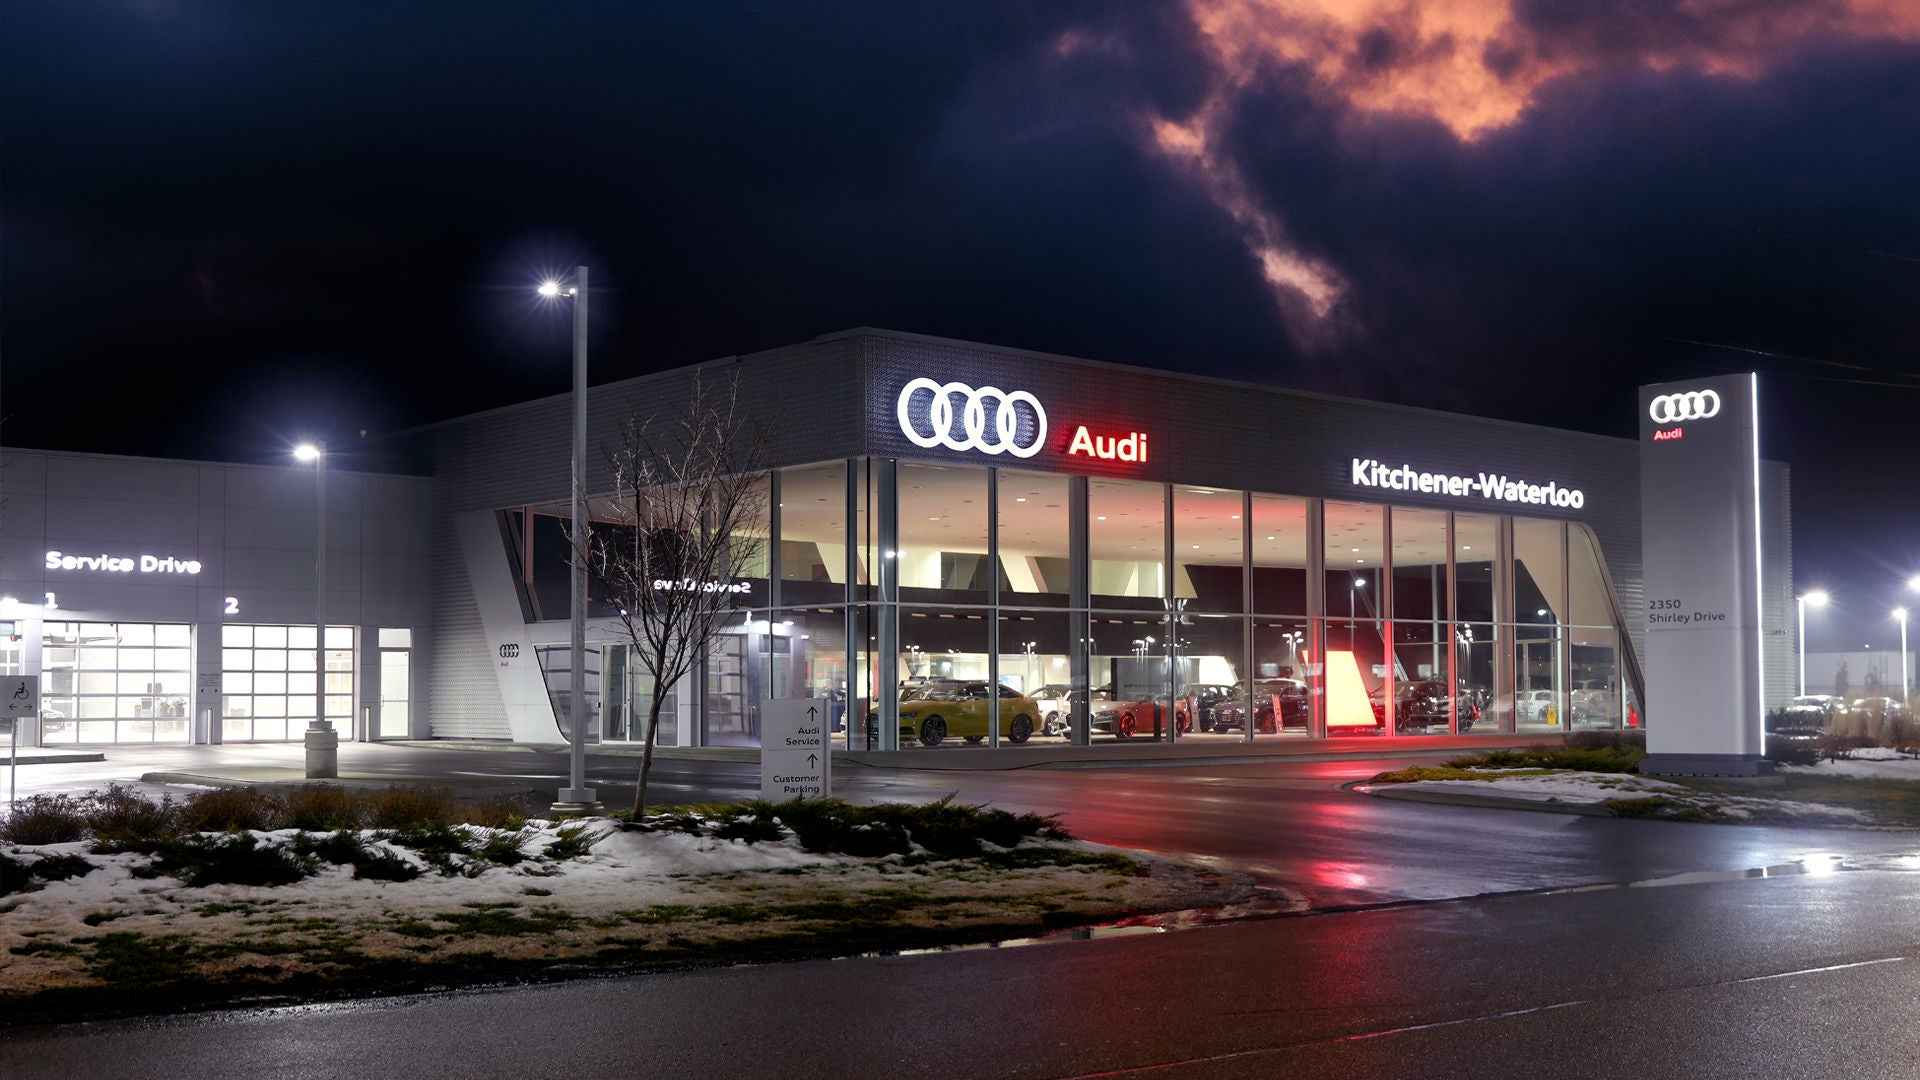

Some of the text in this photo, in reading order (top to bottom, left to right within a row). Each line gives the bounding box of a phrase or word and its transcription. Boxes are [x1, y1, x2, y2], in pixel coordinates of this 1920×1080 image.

[1653, 427, 1683, 441] Audi
[1068, 425, 1147, 462] Audi
[1352, 458, 1584, 508] Kitchener-Waterloo
[45, 551, 202, 574] Service Drive
[45, 592, 58, 609] 1
[224, 597, 239, 614] 2
[1649, 599, 1682, 610] 2350
[1649, 612, 1726, 625] Shirley Drive
[798, 727, 820, 735] Audi
[785, 737, 820, 745] Service
[772, 775, 820, 783] Customer
[783, 786, 820, 794] Parking
